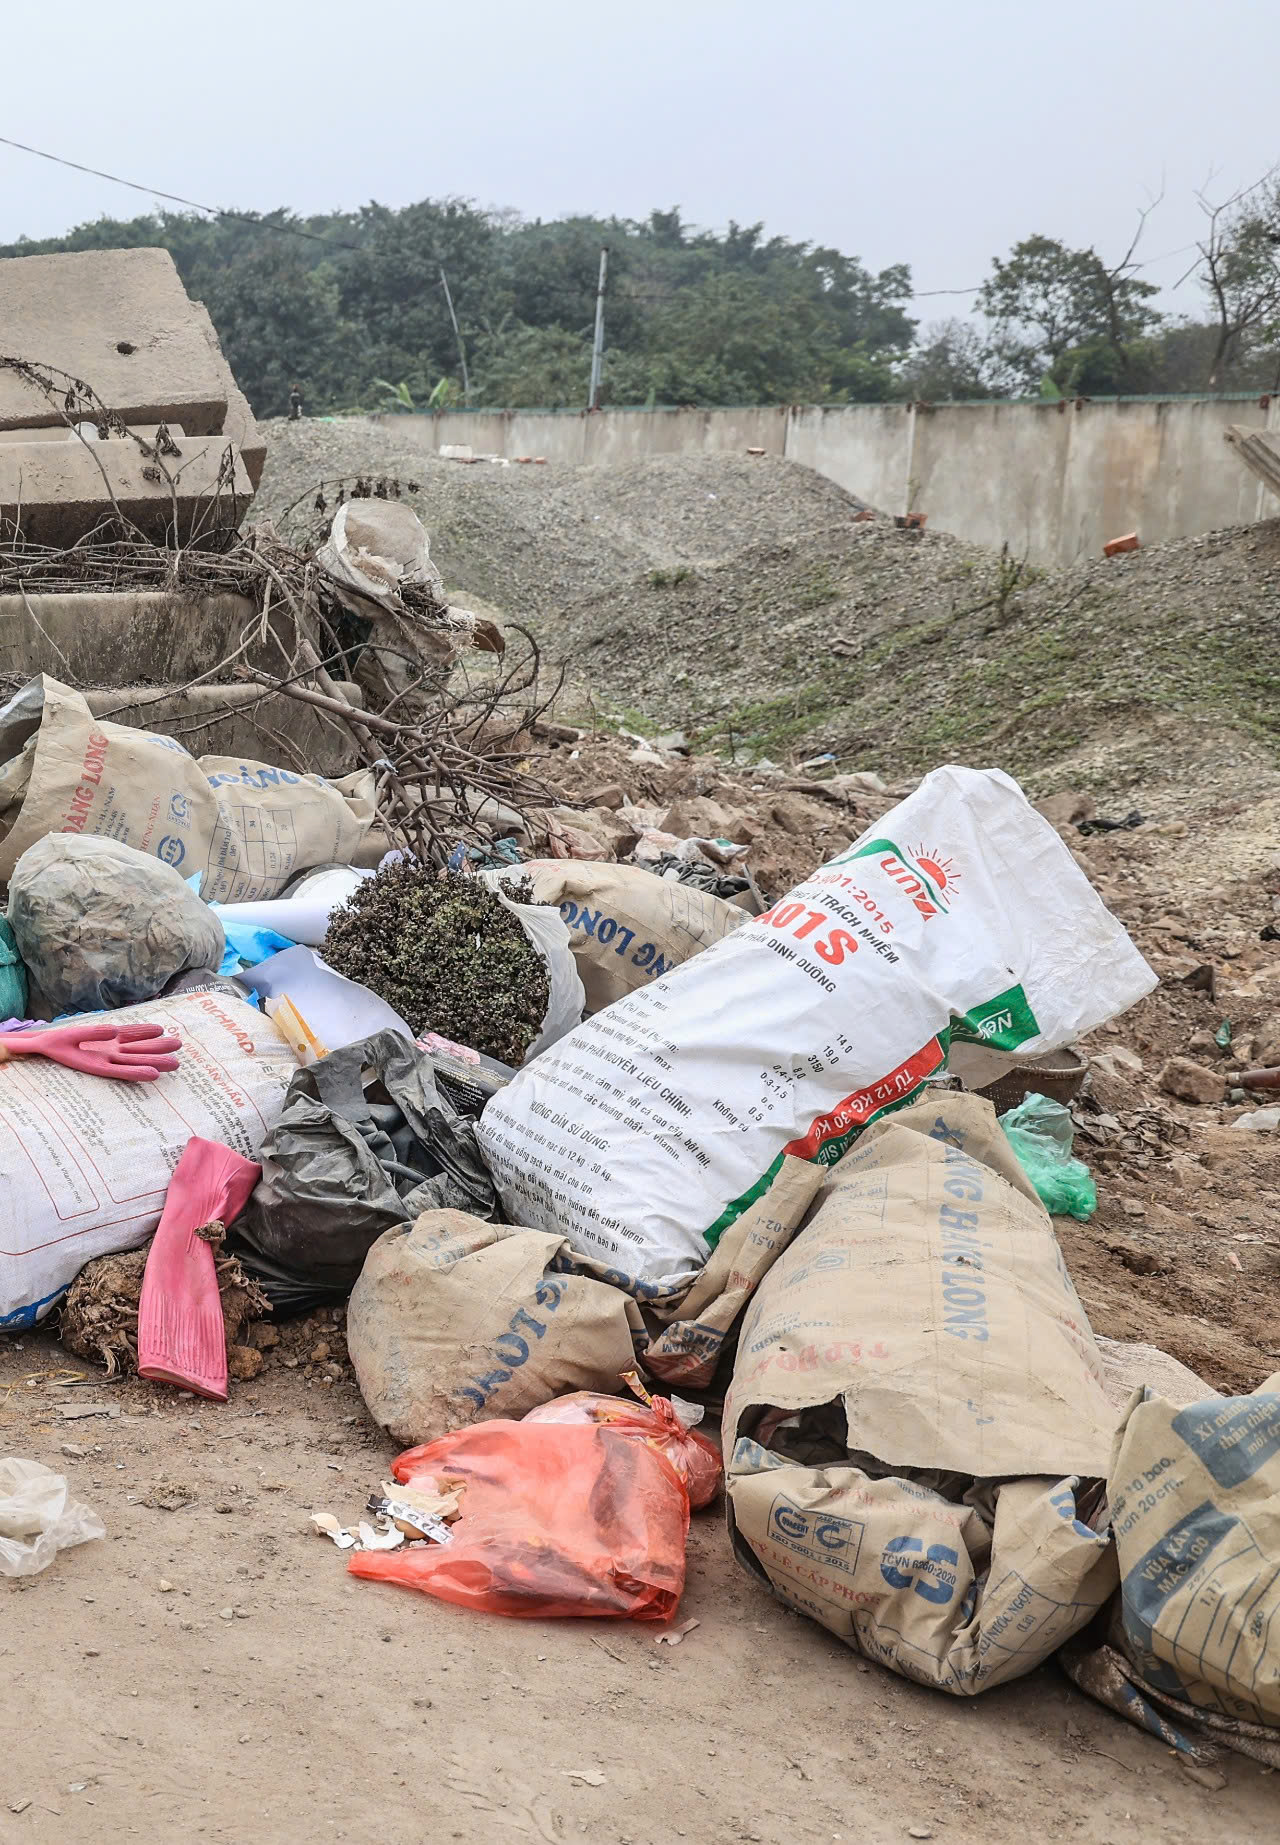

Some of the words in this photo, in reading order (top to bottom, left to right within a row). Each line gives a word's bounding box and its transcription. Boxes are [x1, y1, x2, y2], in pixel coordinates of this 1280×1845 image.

[81, 735, 109, 786] LONG
[559, 901, 636, 956] LONG
[818, 891, 862, 930] TRÁCH
[860, 926, 901, 966] NHIỆM
[766, 936, 797, 962] DINH
[795, 955, 838, 994] DƯỠNG
[653, 1054, 674, 1073] max:
[806, 1052, 824, 1075] 3150
[893, 1067, 914, 1091] TỪ
[603, 1049, 639, 1074] NGUYÊN
[635, 1070, 661, 1091] LIỆU
[658, 1086, 695, 1120] CHÍNH:
[874, 1082, 892, 1099] 12
[582, 1090, 601, 1106] các
[622, 1112, 647, 1133] chất
[711, 1098, 738, 1126] Không
[578, 1128, 611, 1153] DỤNG:
[651, 1112, 668, 1128] cao
[682, 1136, 699, 1155] bột
[566, 1149, 576, 1160] 12
[575, 1155, 586, 1168] kg
[590, 1162, 601, 1174] 30
[599, 1168, 614, 1183] kg.
[600, 1215, 621, 1232] chất
[944, 1274, 986, 1340] LONG
[1194, 1419, 1215, 1441] Xi
[823, 1554, 851, 1571] 2015
[879, 1552, 910, 1569] TCVN
[911, 1559, 957, 1585] 6260:2020
[1139, 1551, 1171, 1584] VỮA
[1164, 1525, 1194, 1559] XÂY
[1154, 1558, 1190, 1595] MÁC
[1184, 1534, 1209, 1565] 100
[793, 1563, 830, 1587] CẤP
[1007, 1584, 1035, 1617] NGỌT
